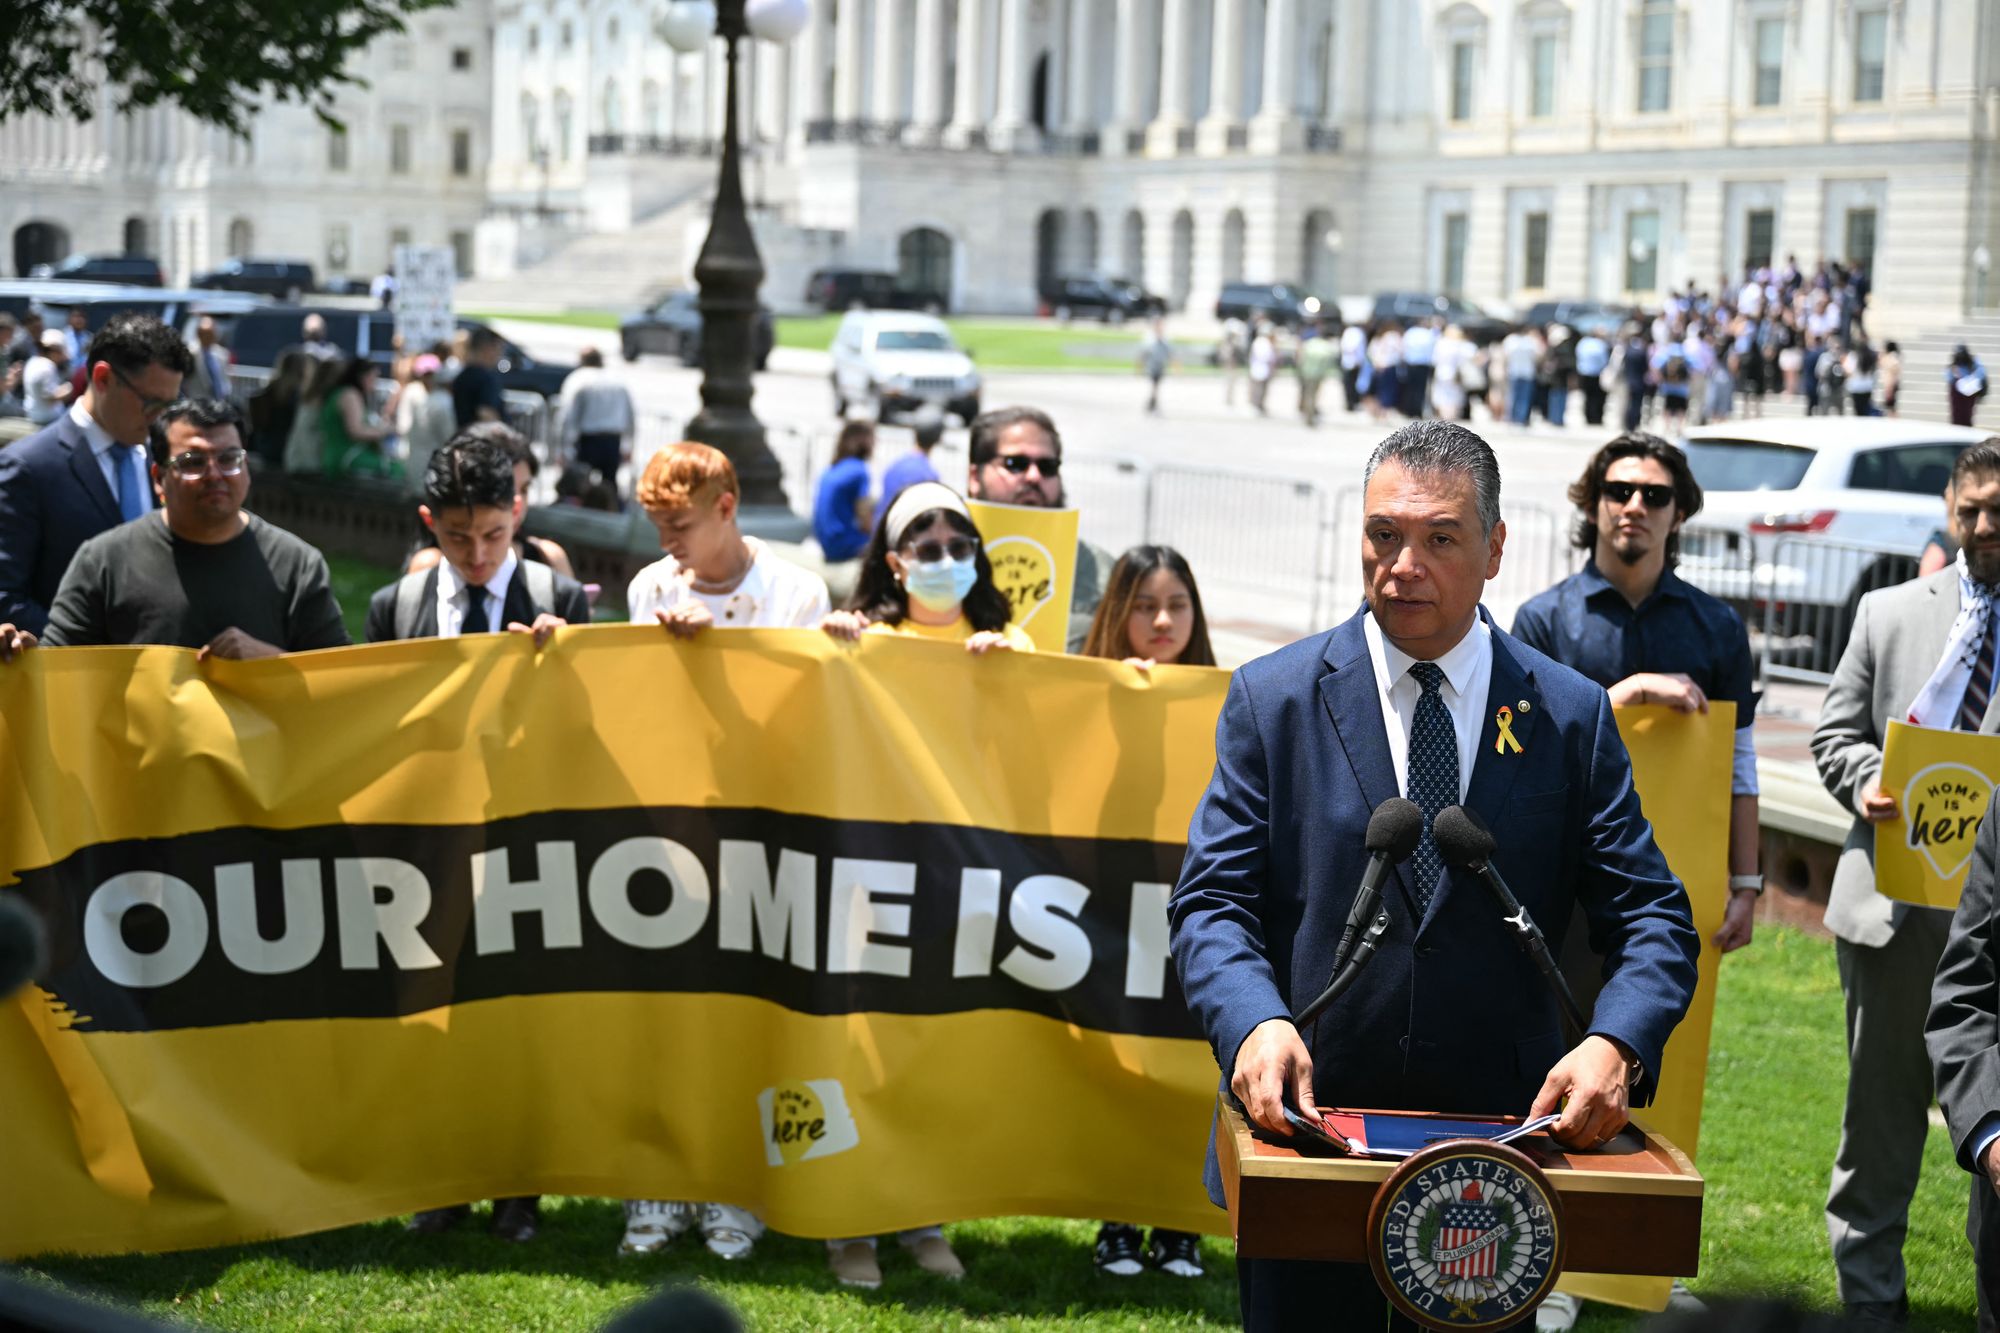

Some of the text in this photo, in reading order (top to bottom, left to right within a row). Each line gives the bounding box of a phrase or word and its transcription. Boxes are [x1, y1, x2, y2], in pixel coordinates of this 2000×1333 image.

[1926, 782, 1981, 804] HOME
[1944, 799, 1960, 811] IS
[83, 856, 444, 989] OUR
[470, 835, 917, 978] HOME
[952, 867, 1093, 992] IS
[1386, 1160, 1551, 1312] UNITED STATES SENATE
[1434, 1226, 1505, 1260] E PLURIBUS UNUM
